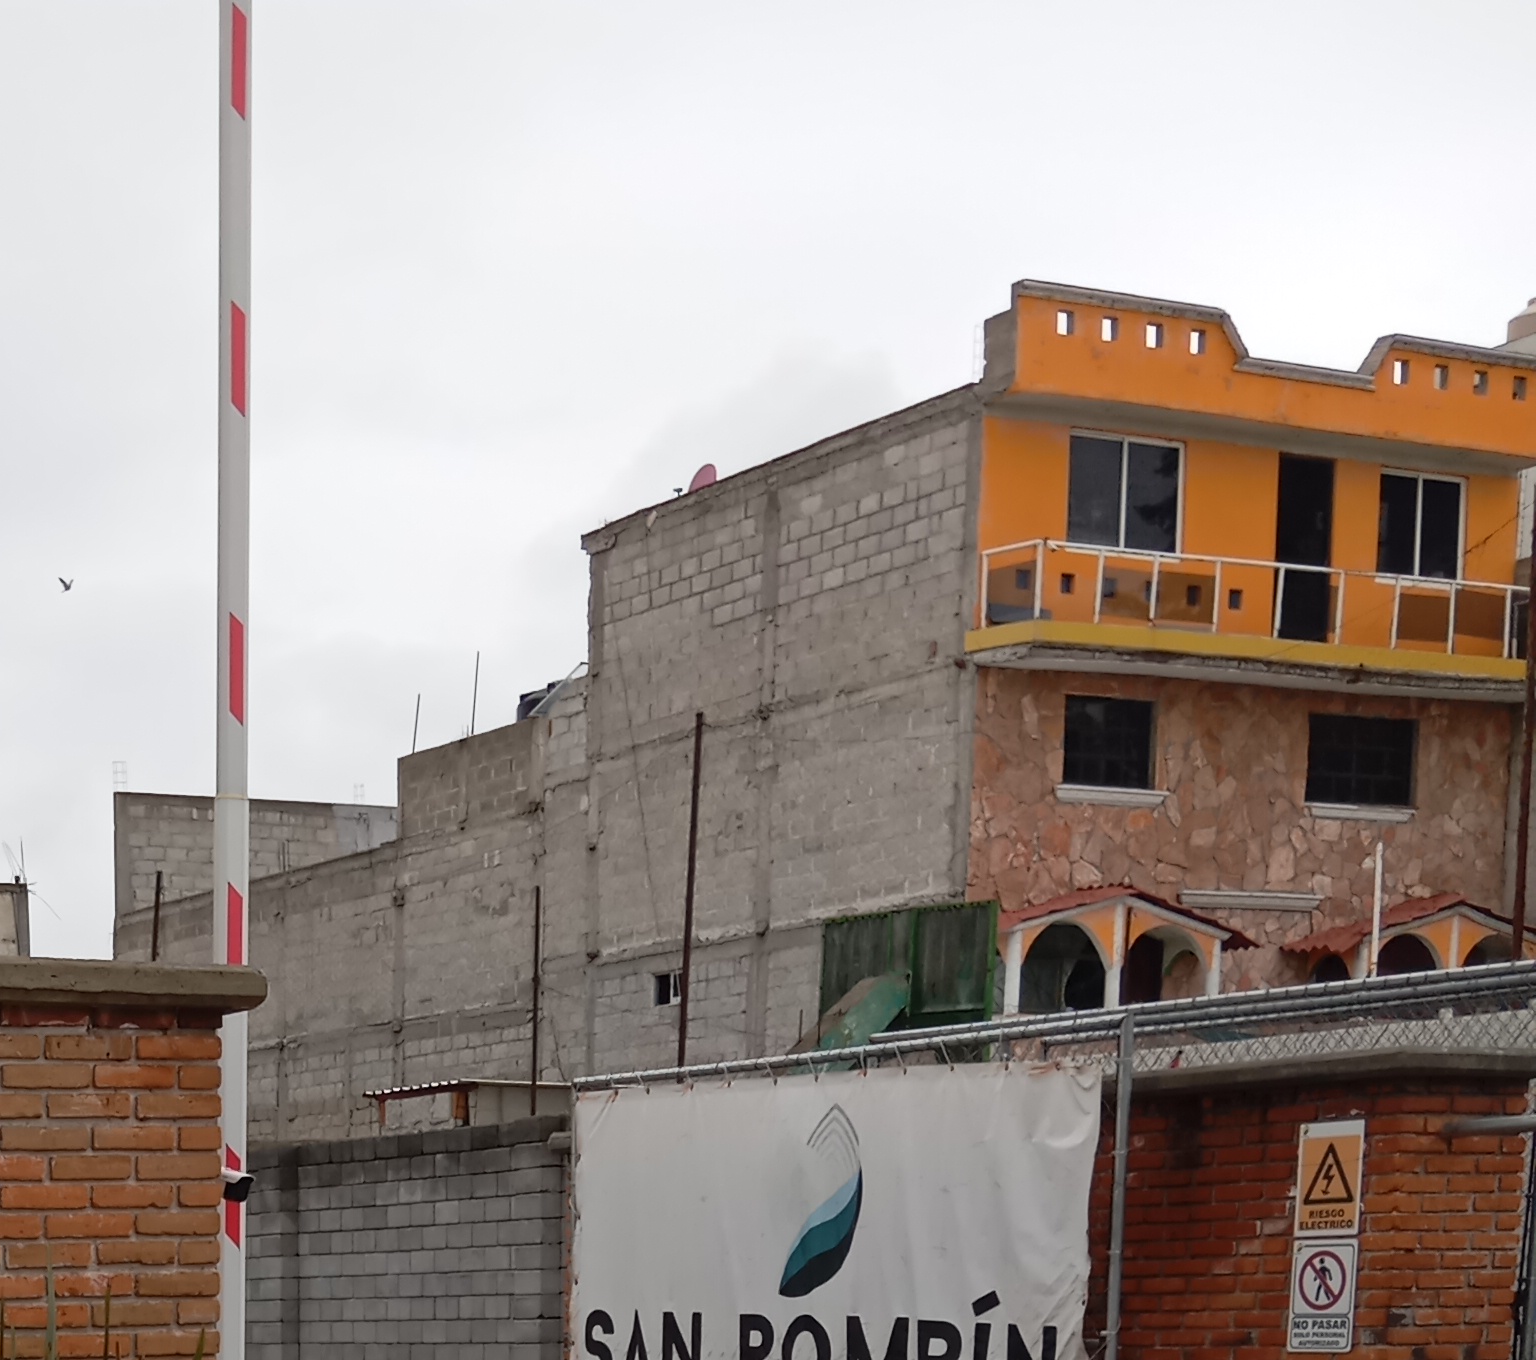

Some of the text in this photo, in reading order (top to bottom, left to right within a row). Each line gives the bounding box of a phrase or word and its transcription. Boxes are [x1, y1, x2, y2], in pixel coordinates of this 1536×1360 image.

[1308, 1209, 1345, 1219] RIESGO
[1299, 1219, 1353, 1230] ELECTRICO
[1293, 1320, 1347, 1330] NO PASAR
